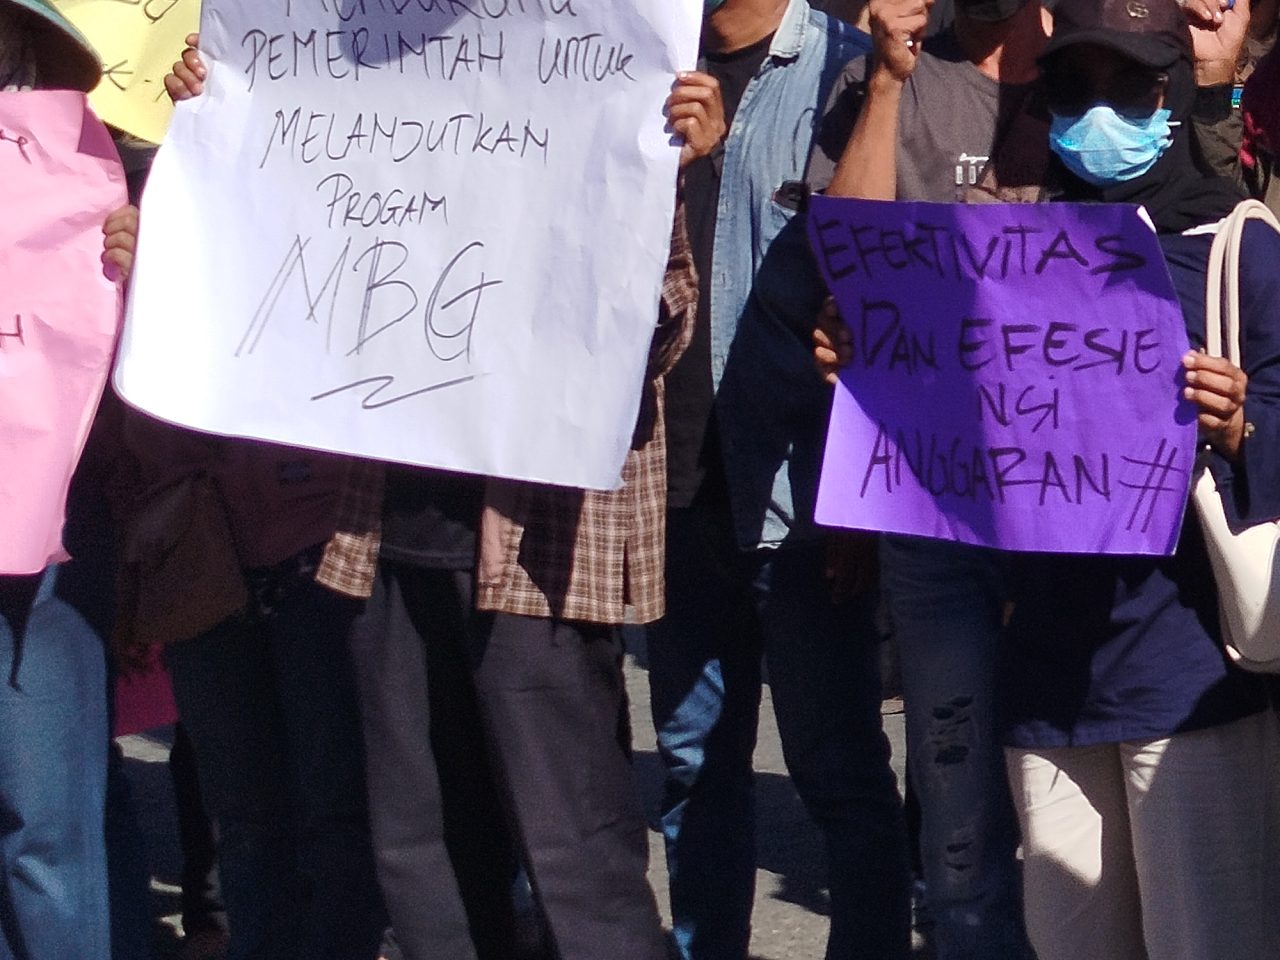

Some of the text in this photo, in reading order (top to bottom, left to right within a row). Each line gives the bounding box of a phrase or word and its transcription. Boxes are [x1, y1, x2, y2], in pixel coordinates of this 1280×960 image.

[258, 106, 550, 169] MELANJUTKAN
[316, 172, 449, 229] PROGAM
[234, 233, 504, 364] MBG
[860, 300, 939, 377] DAN
